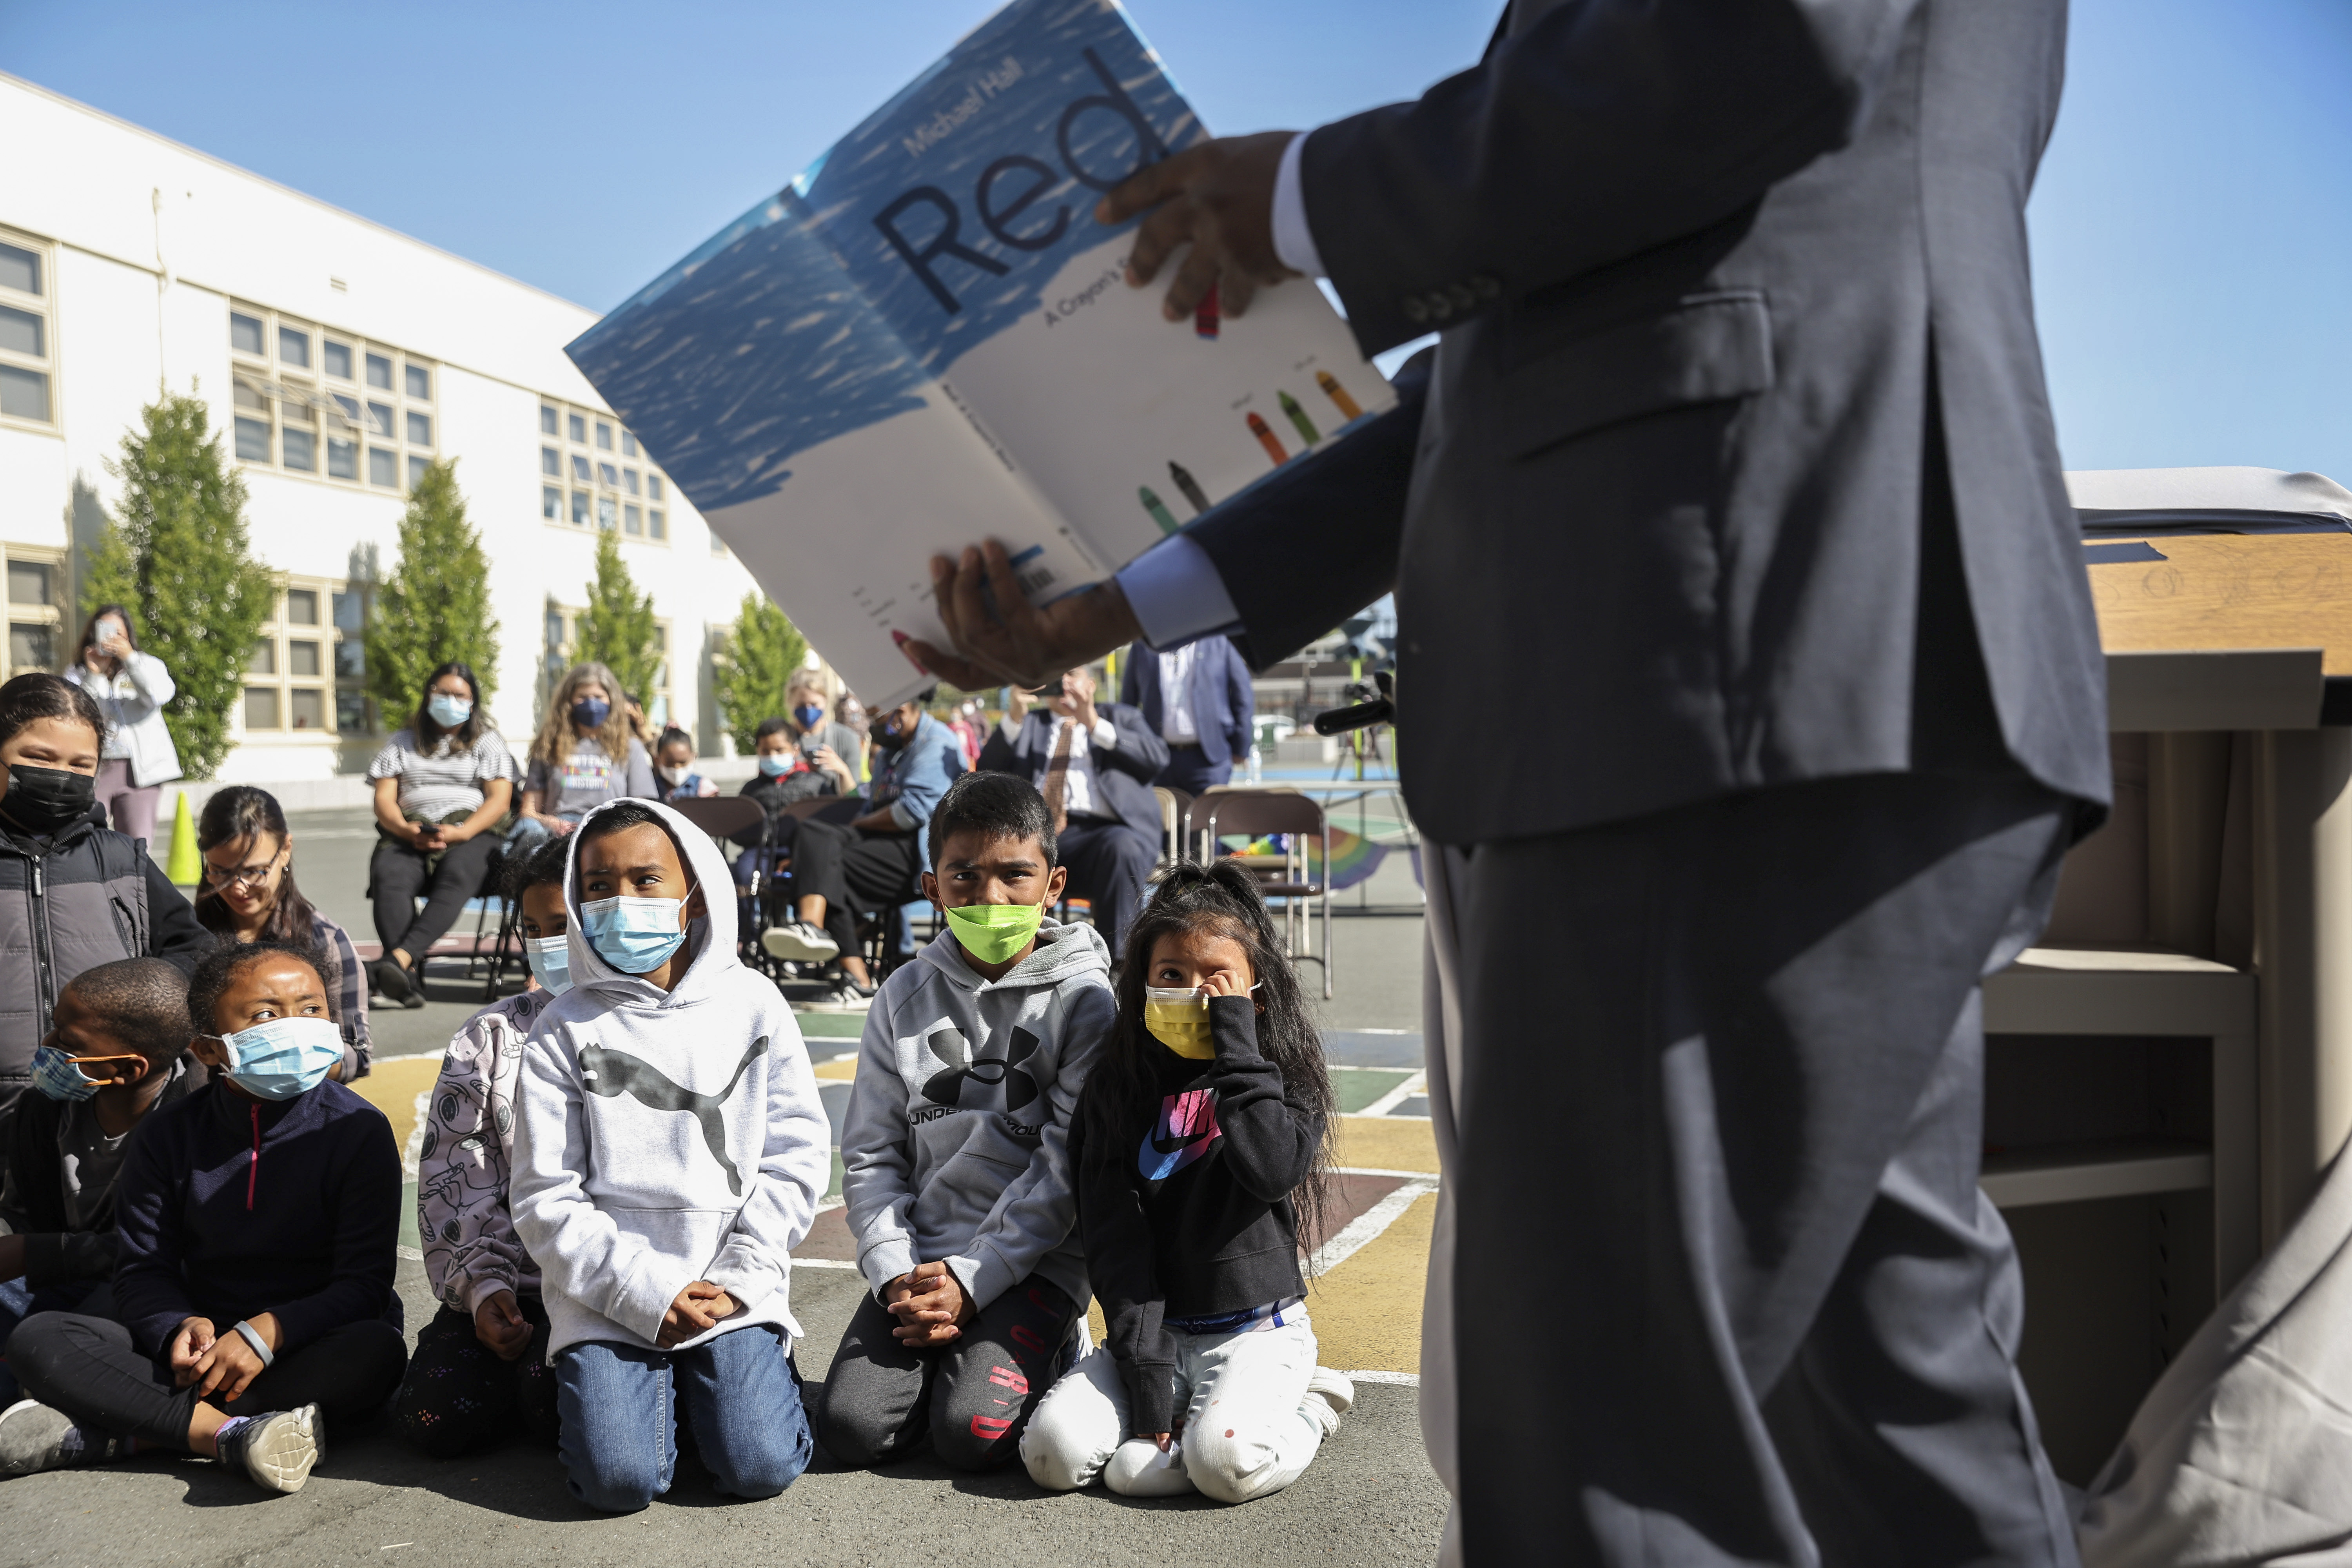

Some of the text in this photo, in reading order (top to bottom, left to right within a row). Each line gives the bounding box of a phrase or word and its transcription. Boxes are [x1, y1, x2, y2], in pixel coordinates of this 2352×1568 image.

[903, 55, 1024, 158] Michael Hall
[872, 45, 1170, 317] Red
[1044, 311, 1062, 328] A
[907, 1108, 971, 1125] UNDE
[1155, 1087, 1220, 1141] NIK
[971, 1289, 1060, 1439] JORD
